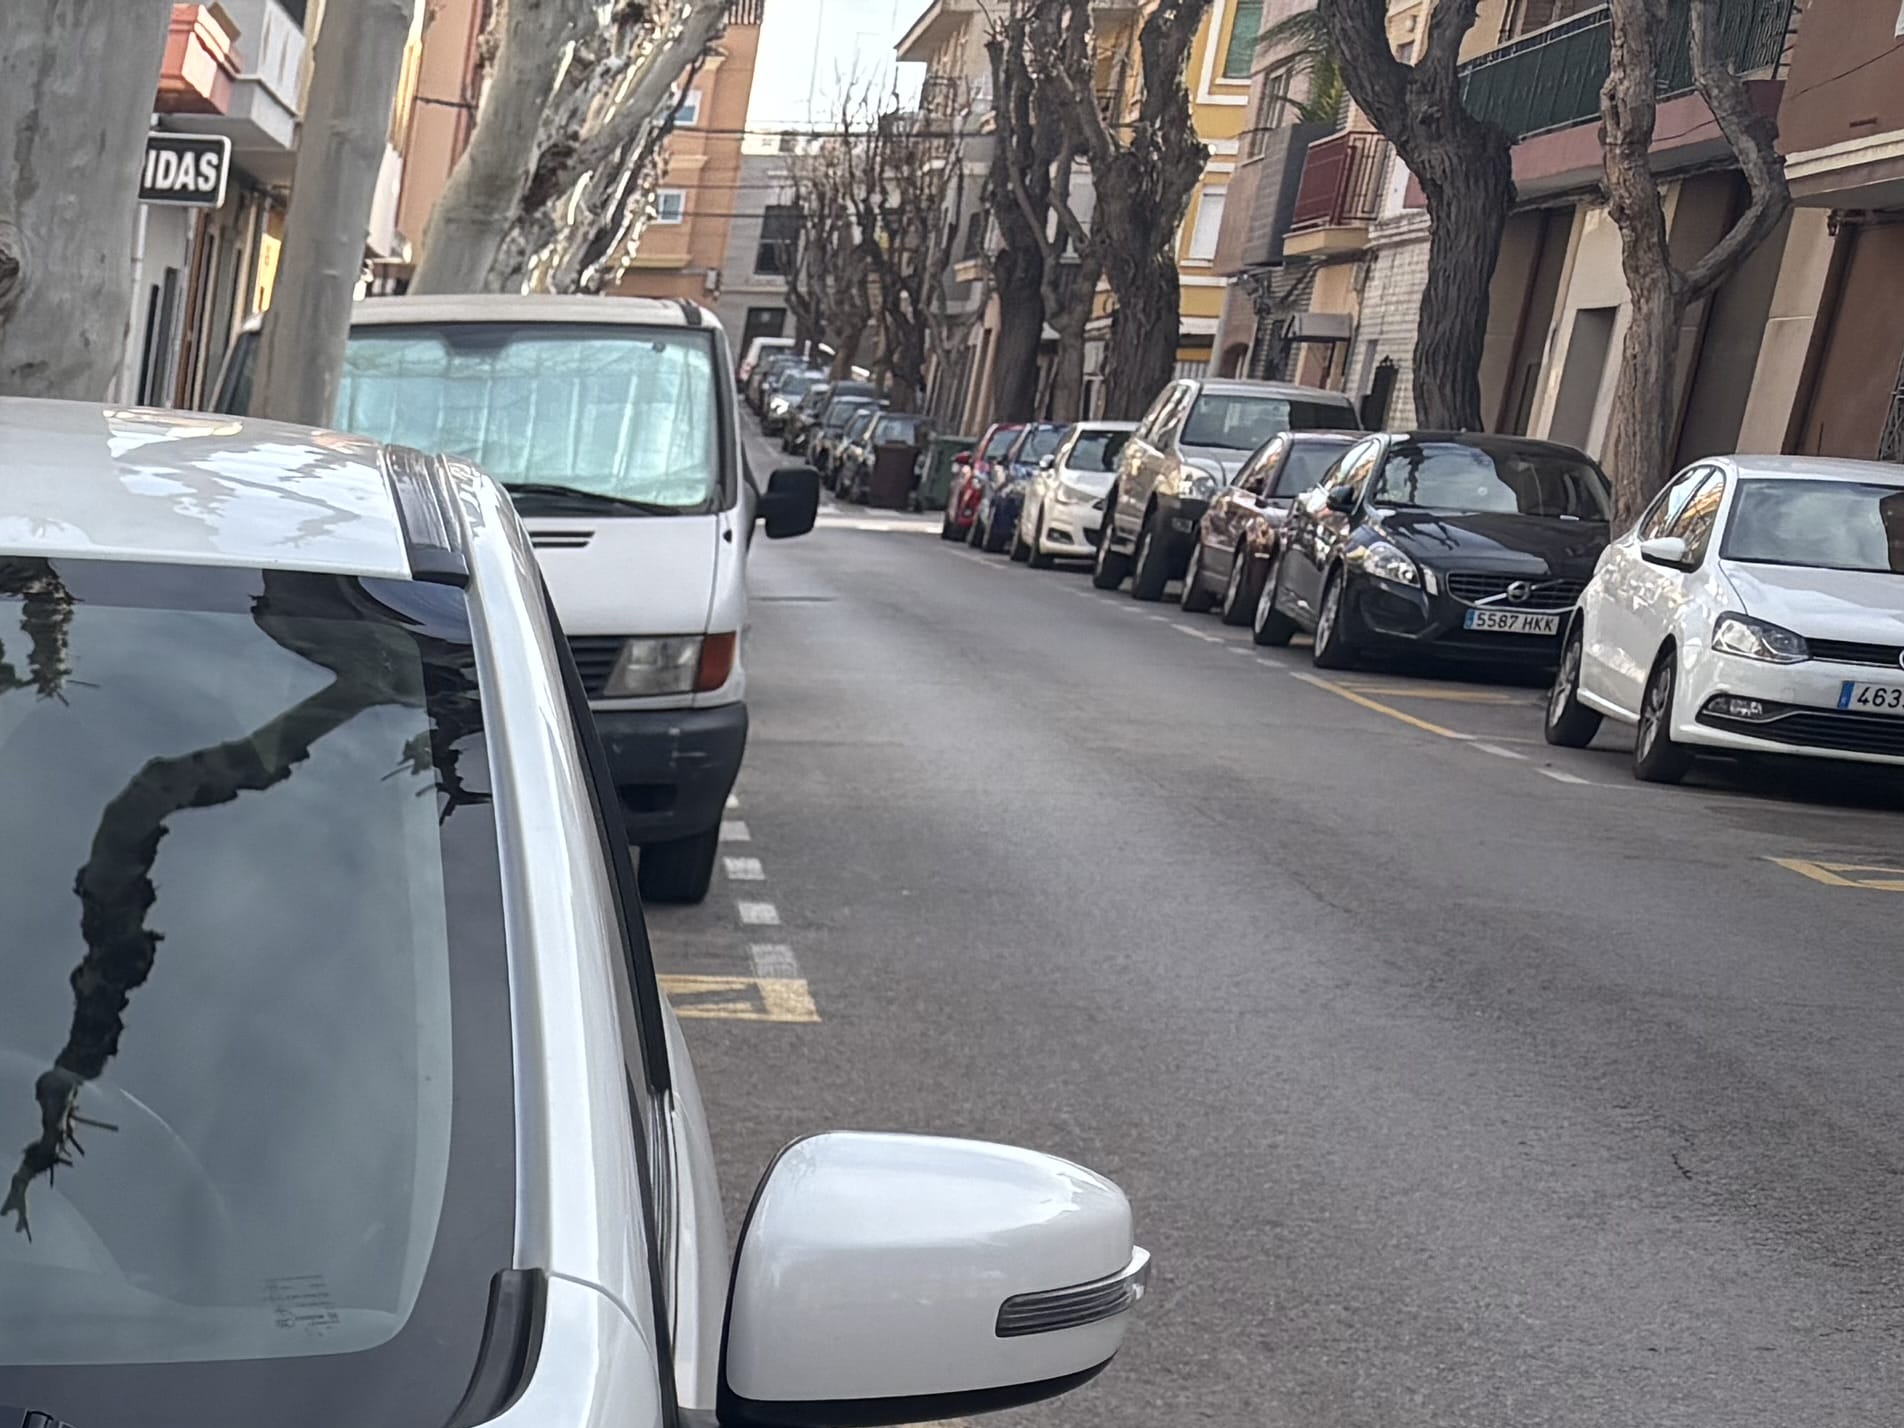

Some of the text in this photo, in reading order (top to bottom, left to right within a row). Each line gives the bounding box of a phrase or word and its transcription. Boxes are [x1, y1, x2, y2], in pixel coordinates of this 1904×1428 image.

[144, 149, 219, 192] IDAS
[1476, 612, 1554, 633] 5587 HKK
[1856, 686, 1904, 708] 463
